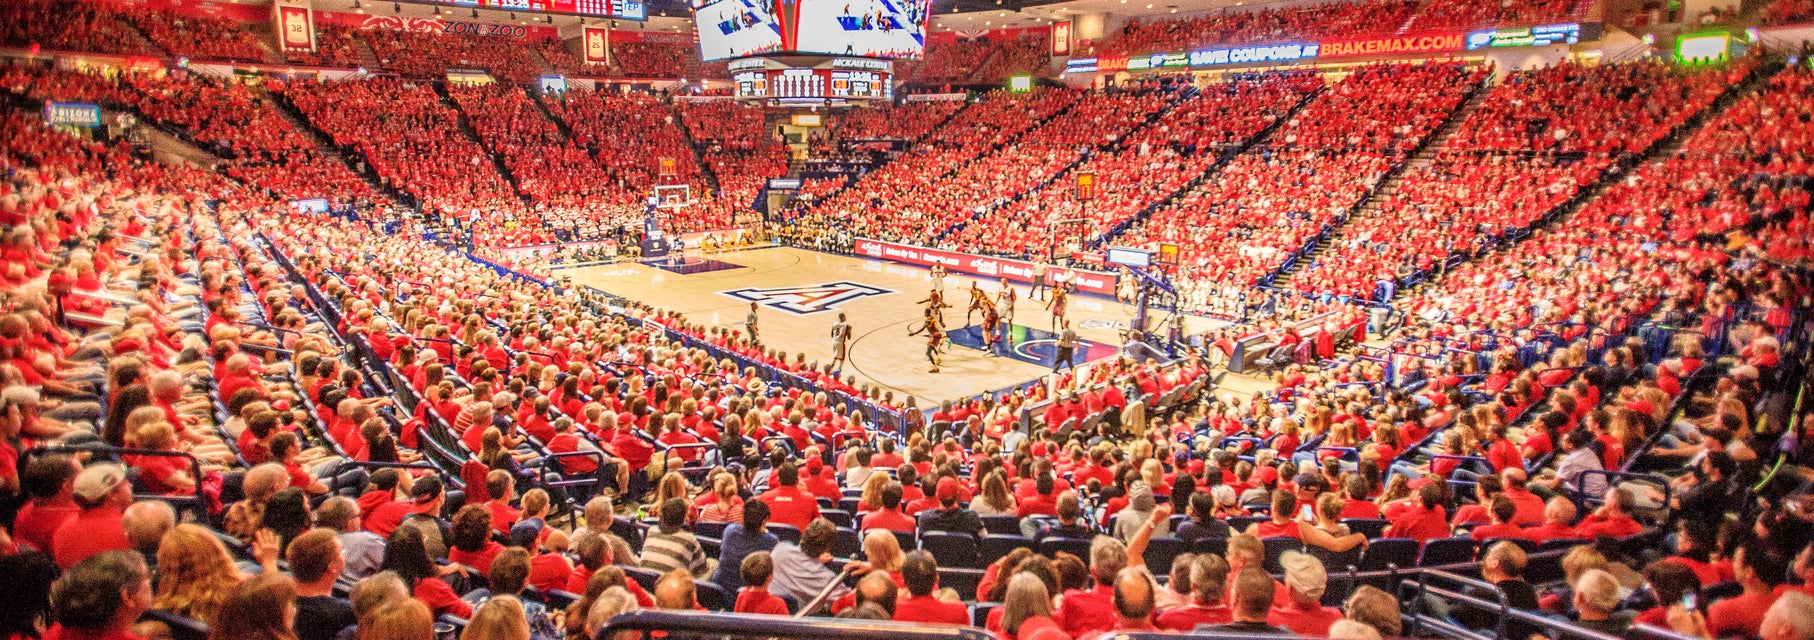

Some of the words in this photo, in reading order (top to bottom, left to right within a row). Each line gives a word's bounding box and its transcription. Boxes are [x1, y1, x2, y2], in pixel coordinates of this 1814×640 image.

[624, 2, 639, 11] TEP
[291, 24, 302, 33] 32
[491, 24, 526, 37] ZOO
[1320, 34, 1463, 56] BRAKEMAX.COM
[1190, 50, 1229, 65] SAVE
[1229, 44, 1302, 63] COUPONS
